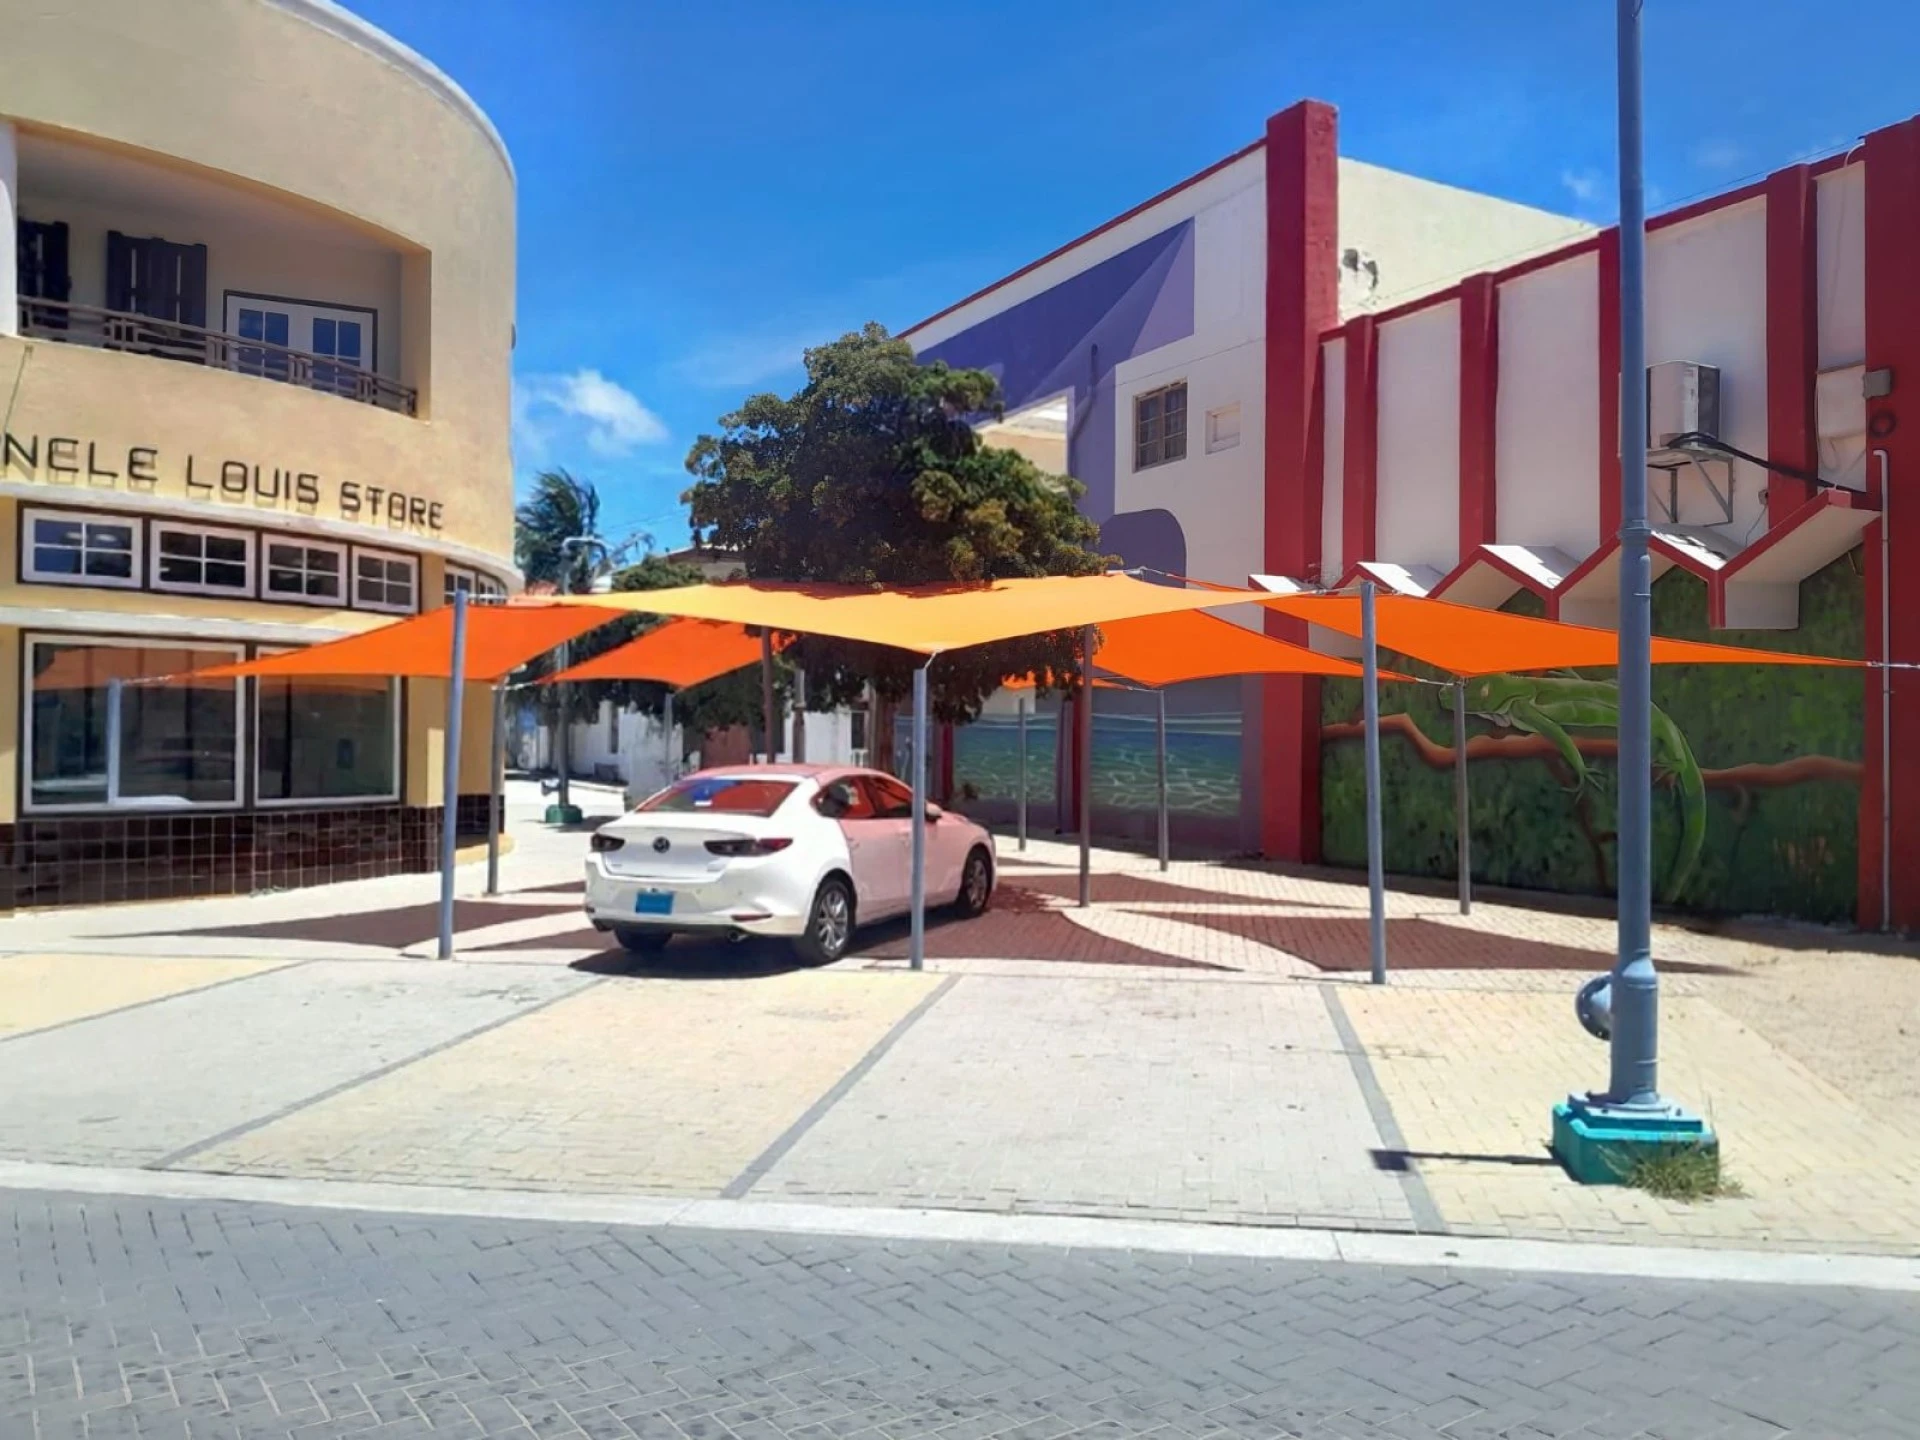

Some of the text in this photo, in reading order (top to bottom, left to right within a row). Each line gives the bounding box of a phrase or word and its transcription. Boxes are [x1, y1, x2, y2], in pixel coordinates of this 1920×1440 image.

[0, 431, 444, 530] NCLE LOUIS STORE
